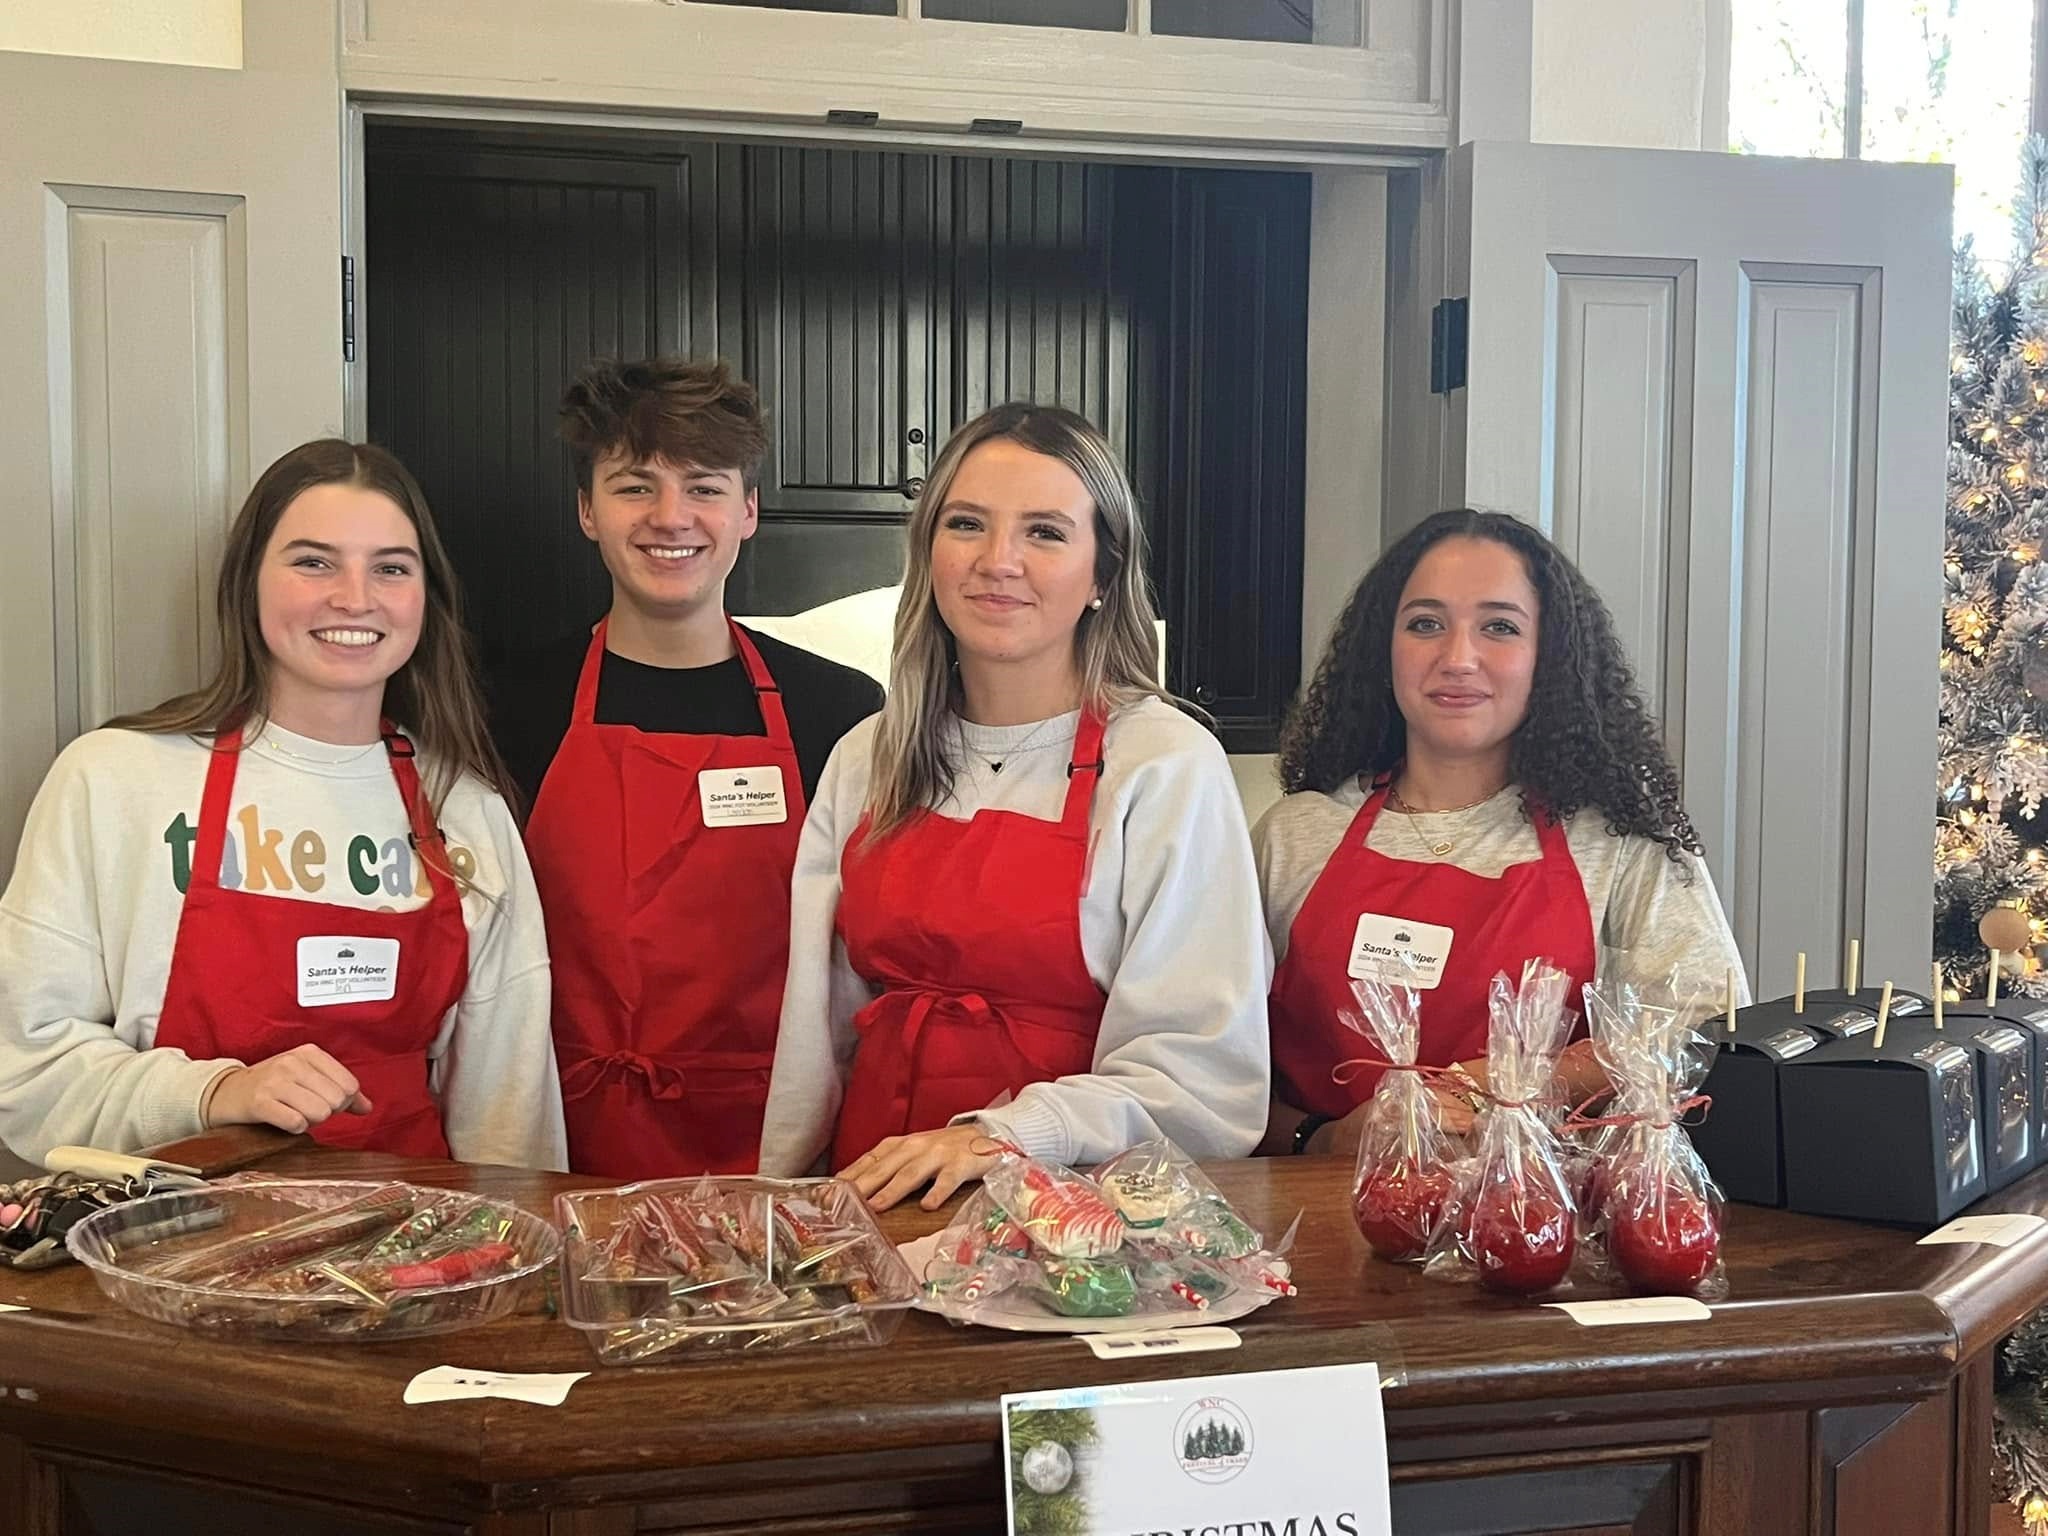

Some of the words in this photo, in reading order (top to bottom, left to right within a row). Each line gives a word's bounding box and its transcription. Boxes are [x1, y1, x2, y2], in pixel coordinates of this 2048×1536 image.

[709, 792, 744, 802] Santa's
[746, 791, 776, 800] Helper
[347, 834, 476, 899] cae
[1361, 942, 1401, 958] Santa's
[307, 966, 346, 977] Santa's
[349, 965, 387, 976] Helper
